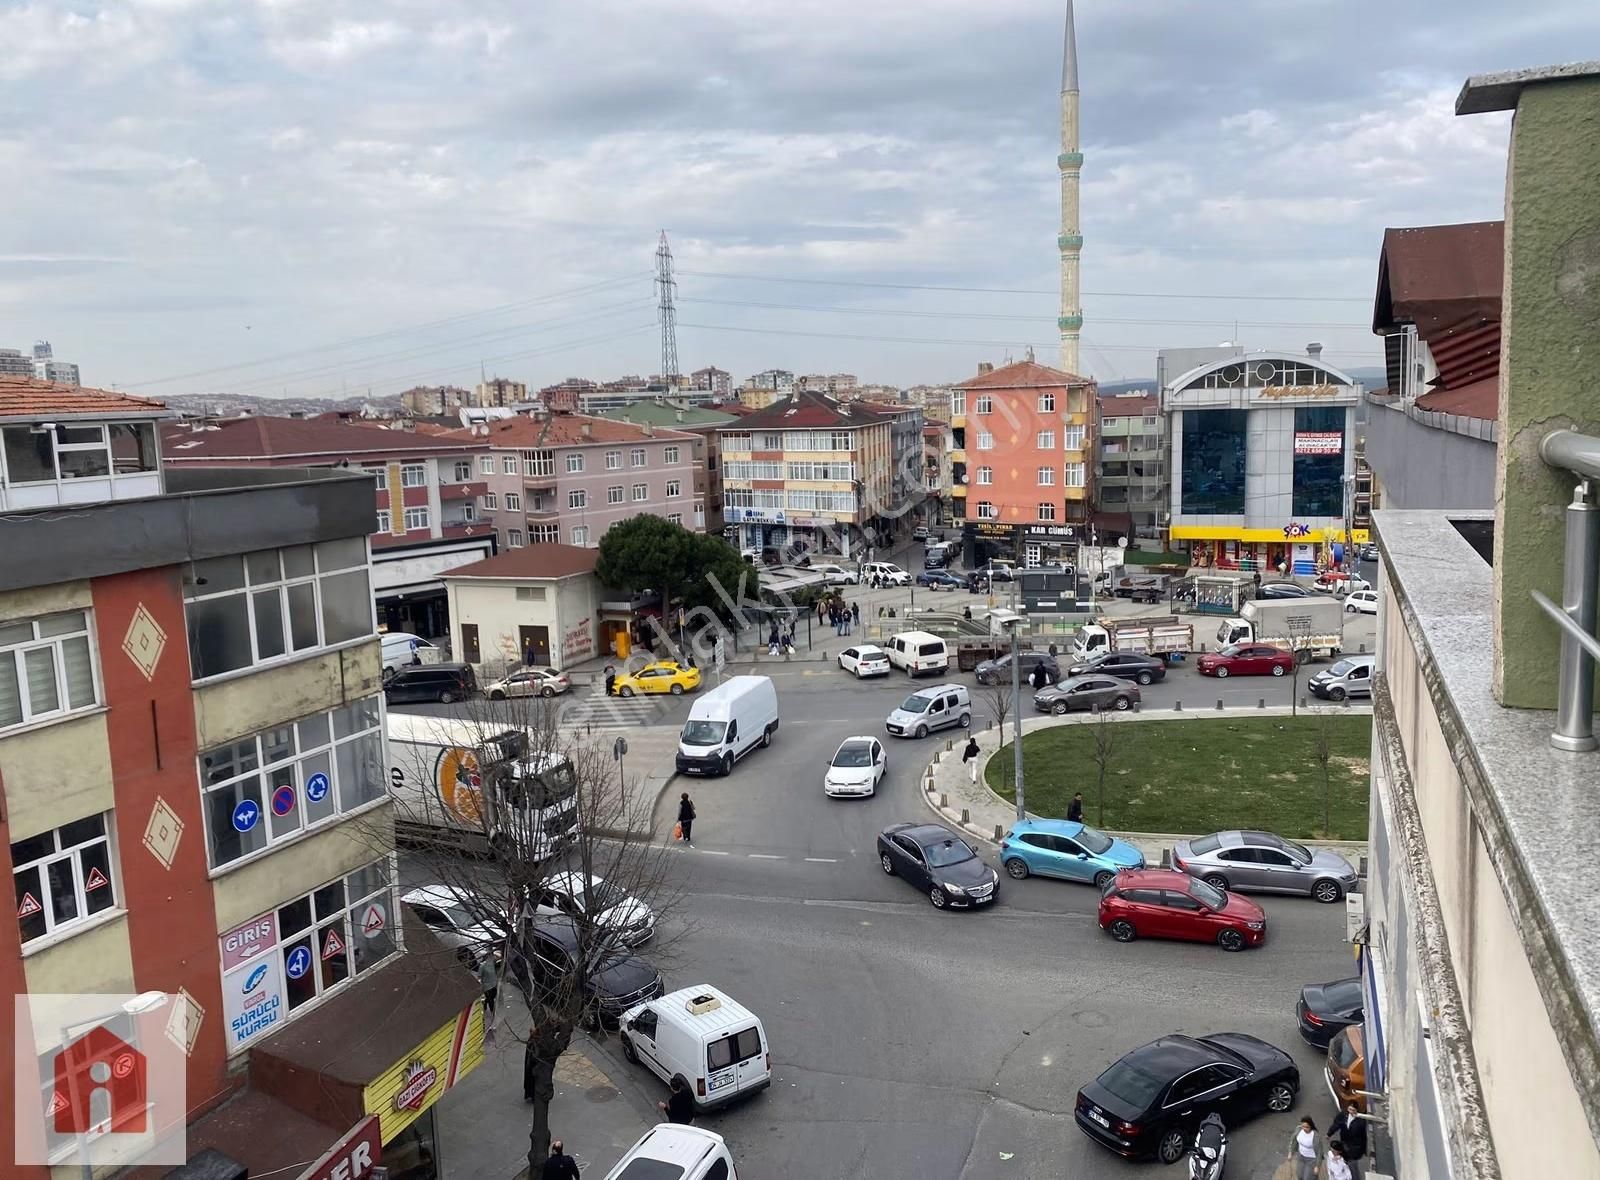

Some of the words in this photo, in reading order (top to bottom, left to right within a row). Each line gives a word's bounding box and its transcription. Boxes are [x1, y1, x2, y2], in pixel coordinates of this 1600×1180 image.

[1031, 526, 1046, 535] KAR
[1048, 525, 1073, 536] GÜMÜŞ
[1283, 523, 1311, 540] ŞOK
[226, 920, 271, 952] GİRİŞ
[232, 994, 280, 1031] SÜRÜCÜ
[237, 1010, 277, 1041] KURSU
